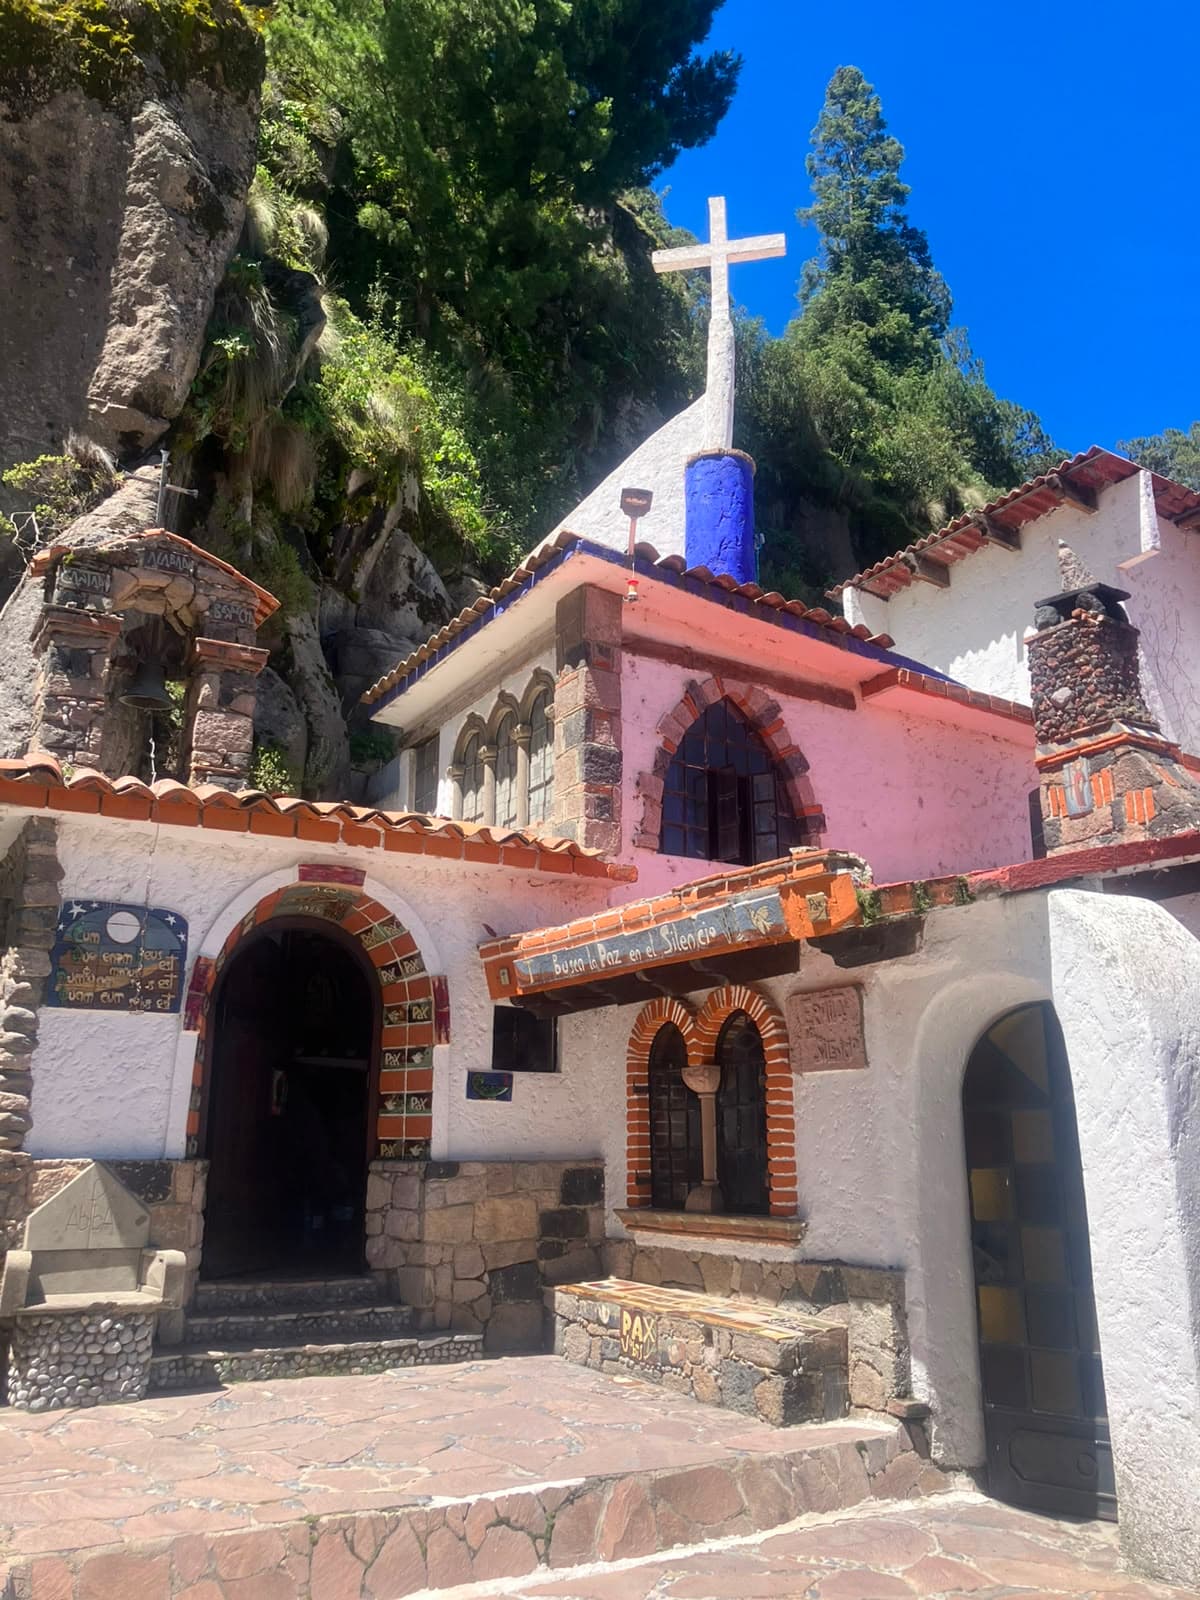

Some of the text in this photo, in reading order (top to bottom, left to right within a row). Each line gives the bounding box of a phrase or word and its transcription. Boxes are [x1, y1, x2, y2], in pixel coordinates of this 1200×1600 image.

[72, 922, 100, 945] Cum
[552, 921, 717, 975] Busca la Paz en el Silencio
[622, 1310, 656, 1343] PAX
